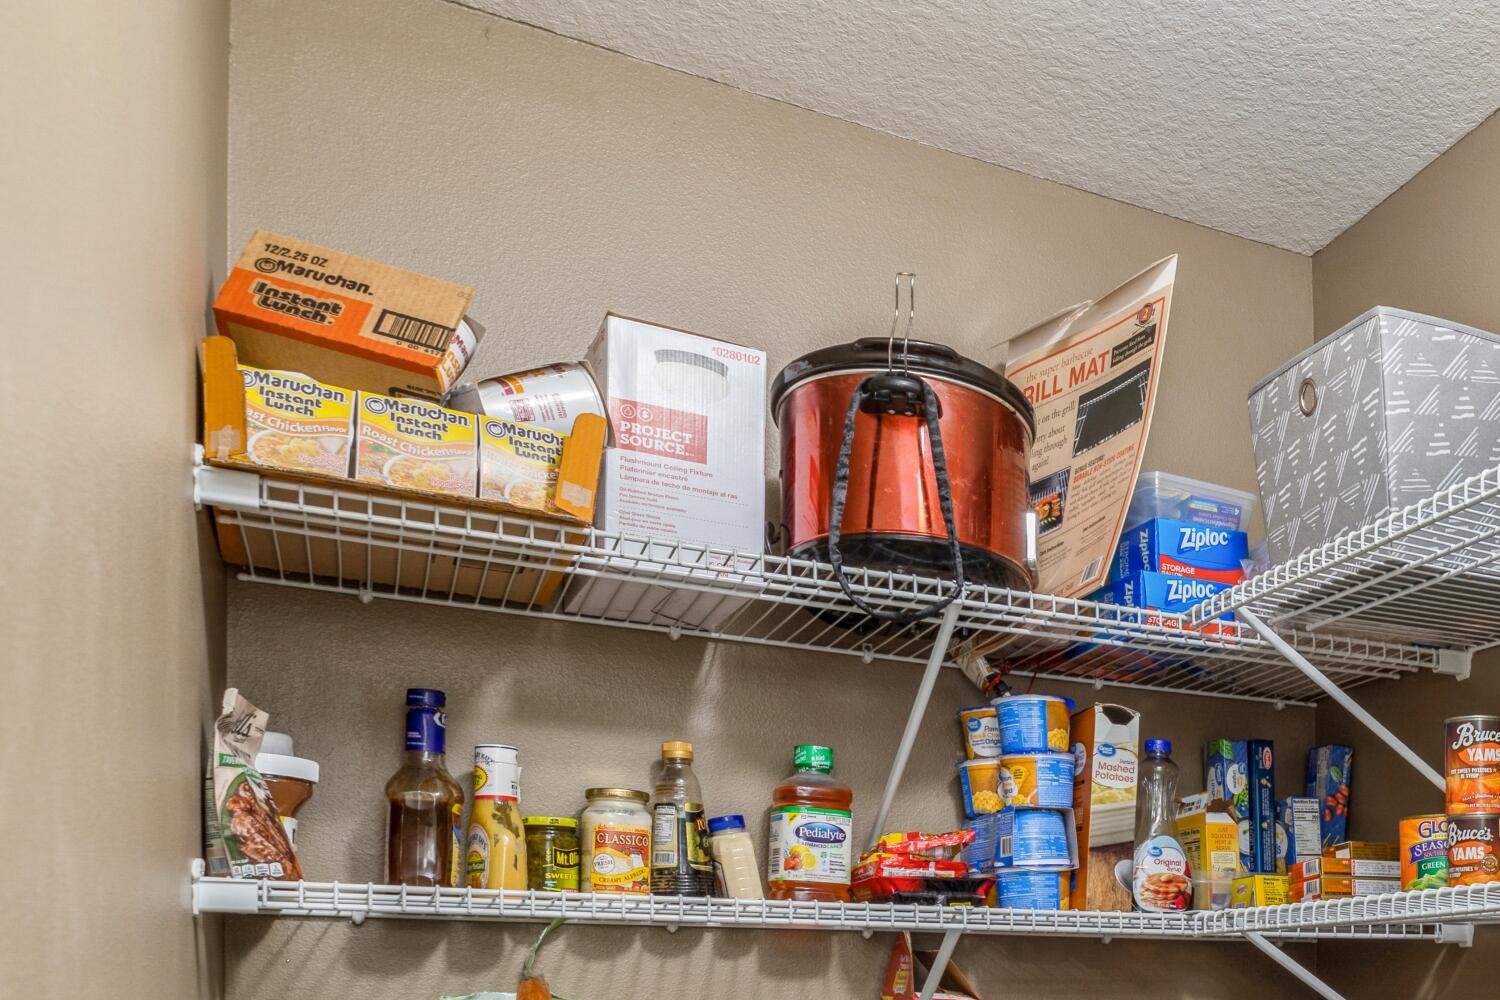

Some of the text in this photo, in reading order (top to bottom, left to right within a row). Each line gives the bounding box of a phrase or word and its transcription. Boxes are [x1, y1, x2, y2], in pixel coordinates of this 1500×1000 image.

[264, 242, 329, 268] 12/2.25 OZ
[254, 281, 342, 315] Instant
[1039, 364, 1059, 378] super
[1062, 348, 1093, 368] barbecue
[254, 371, 346, 403] Maruchan
[1023, 351, 1109, 406] RILL MAT
[258, 386, 322, 408] Instant
[265, 400, 314, 416] Lunch
[385, 399, 469, 427] Maruchan
[1062, 401, 1075, 416] grill
[267, 416, 322, 432] Chicken
[390, 413, 449, 433] Instant
[397, 424, 442, 441] Lunch
[619, 421, 692, 443] PROJECT
[363, 426, 449, 456] Roast Chicken
[515, 447, 556, 464] Lunch
[620, 456, 714, 478] Flushmount Ceiling Fixture
[662, 481, 719, 498] techo montaje
[1180, 528, 1228, 552] Ziploc
[1139, 529, 1150, 571] Ziploc
[1162, 564, 1196, 575] STORAGE
[1167, 580, 1214, 603] Ziploc
[1468, 749, 1500, 762] YAMS
[1098, 761, 1135, 775] Mashed
[1094, 771, 1135, 783] Potatoes
[596, 832, 648, 846] CLASSICO
[799, 826, 846, 842] Pedialyte
[1452, 847, 1484, 860] YAMS
[594, 860, 613, 868] FRESH
[1154, 858, 1182, 867] Original
[1421, 861, 1446, 870] GREEN
[598, 868, 648, 884] CREAMY ALFREDO
